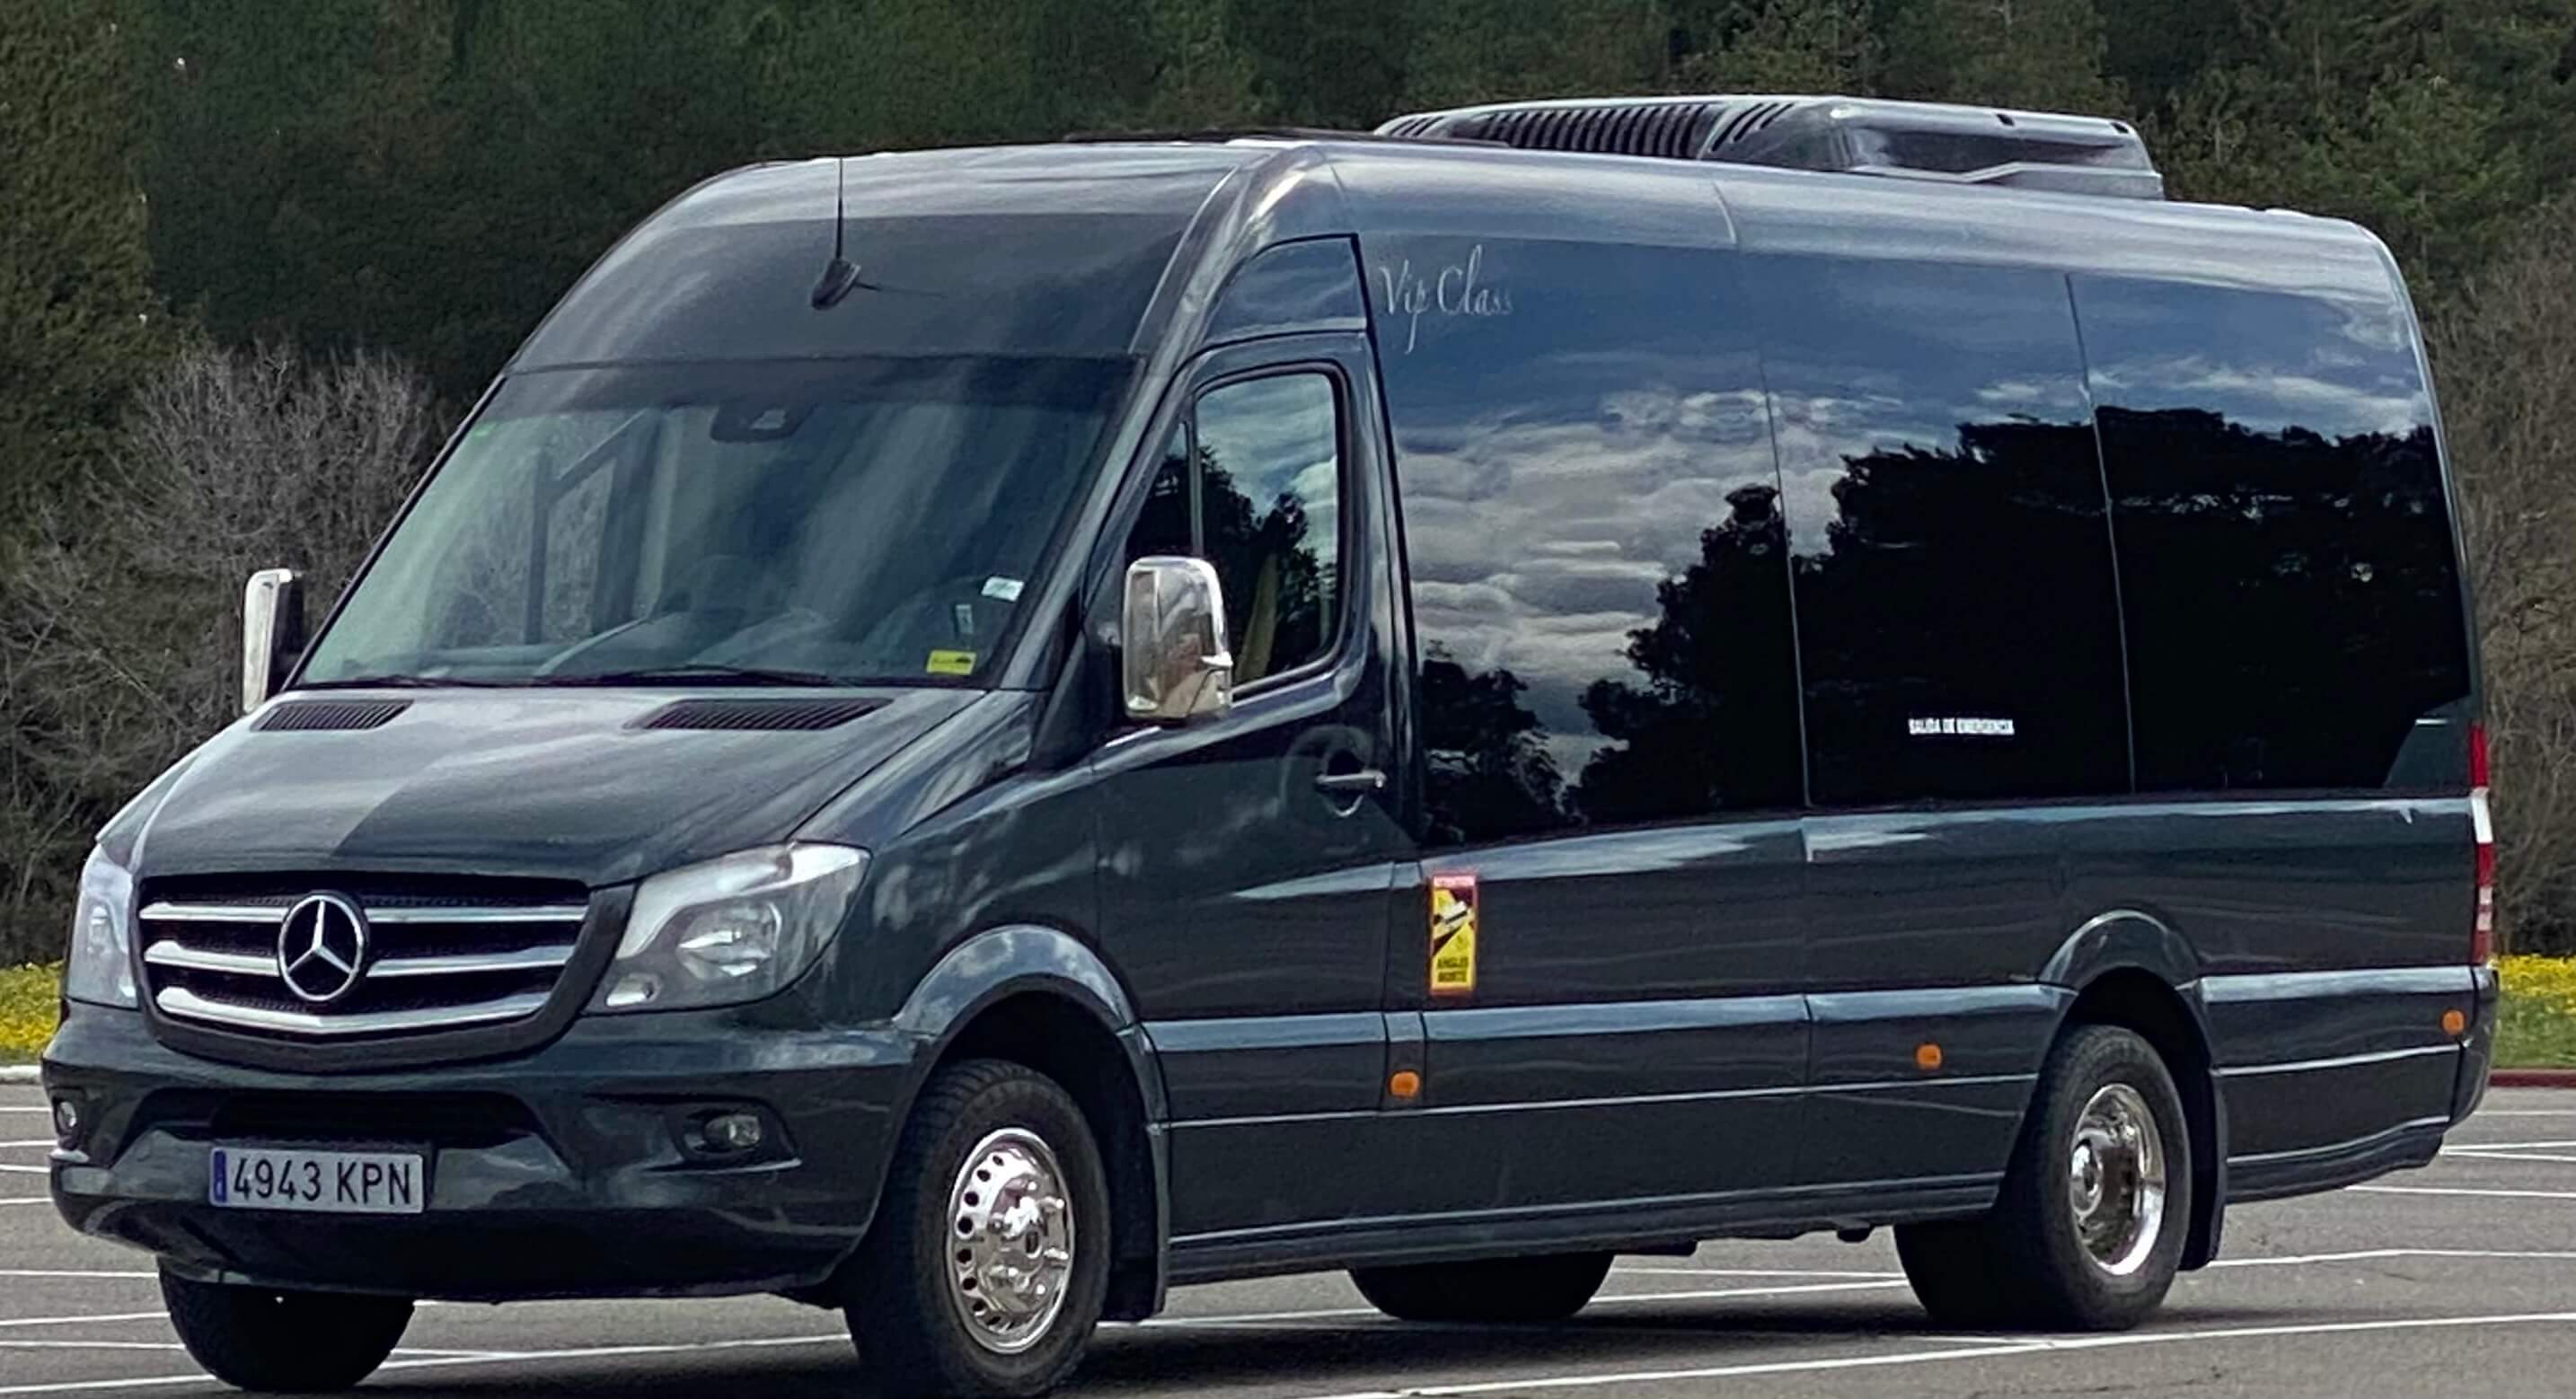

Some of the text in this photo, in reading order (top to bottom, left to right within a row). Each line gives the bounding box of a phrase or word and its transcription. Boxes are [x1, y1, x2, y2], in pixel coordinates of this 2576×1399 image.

[1379, 243, 1515, 356] Vip Class
[233, 1157, 410, 1205] 4943 KPN
